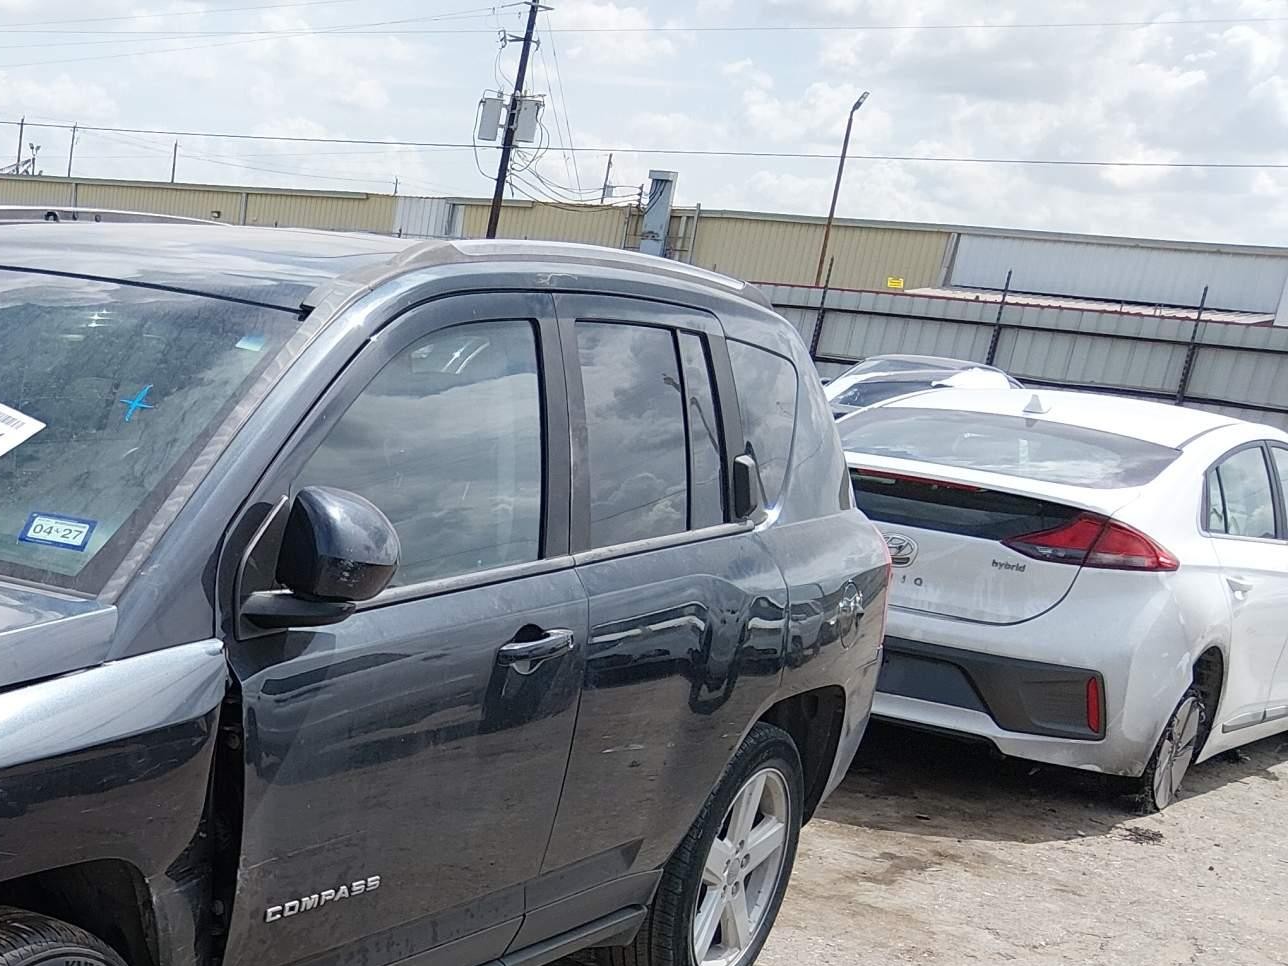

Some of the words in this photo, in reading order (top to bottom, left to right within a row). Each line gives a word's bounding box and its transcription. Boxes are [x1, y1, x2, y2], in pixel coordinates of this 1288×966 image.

[33, 523, 53, 535] 04
[60, 528, 84, 540] 27
[991, 559, 1026, 573] hybrid
[265, 875, 381, 923] COMPASS
